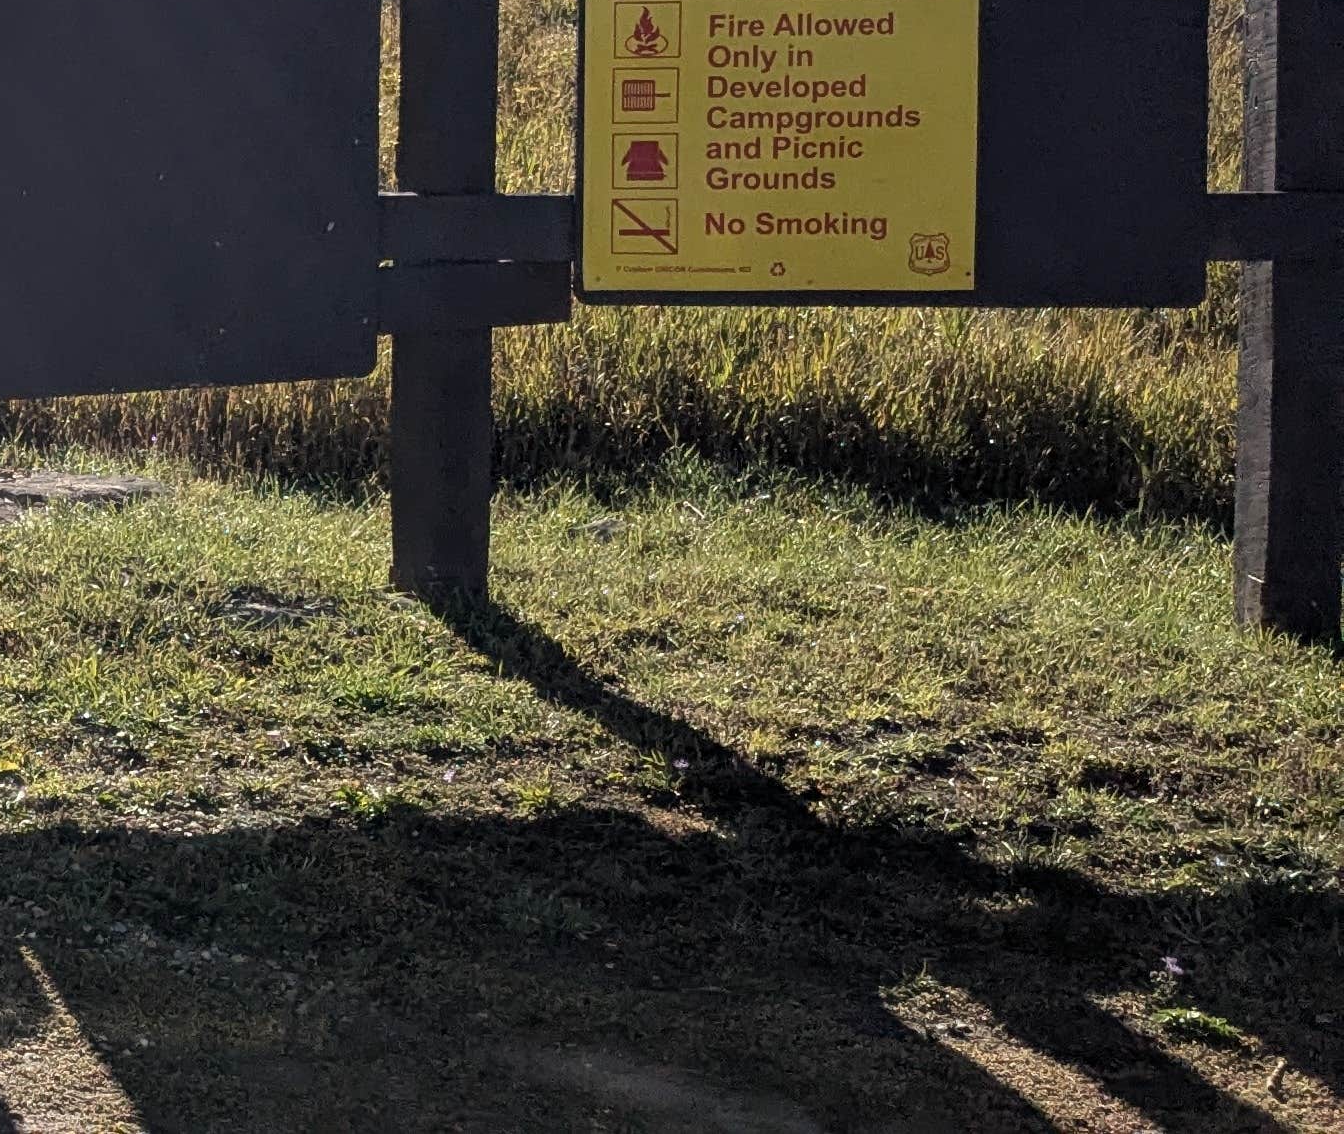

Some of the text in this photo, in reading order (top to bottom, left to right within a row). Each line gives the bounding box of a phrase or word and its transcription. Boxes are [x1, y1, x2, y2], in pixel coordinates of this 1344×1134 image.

[709, 12, 894, 37] Fire Allowed
[708, 45, 813, 73] Only in
[707, 75, 866, 102] Developed
[706, 105, 921, 134] Campgrounds
[706, 137, 863, 159] and Picnic
[706, 167, 836, 190] Grounds
[704, 212, 887, 240] No Smoking
